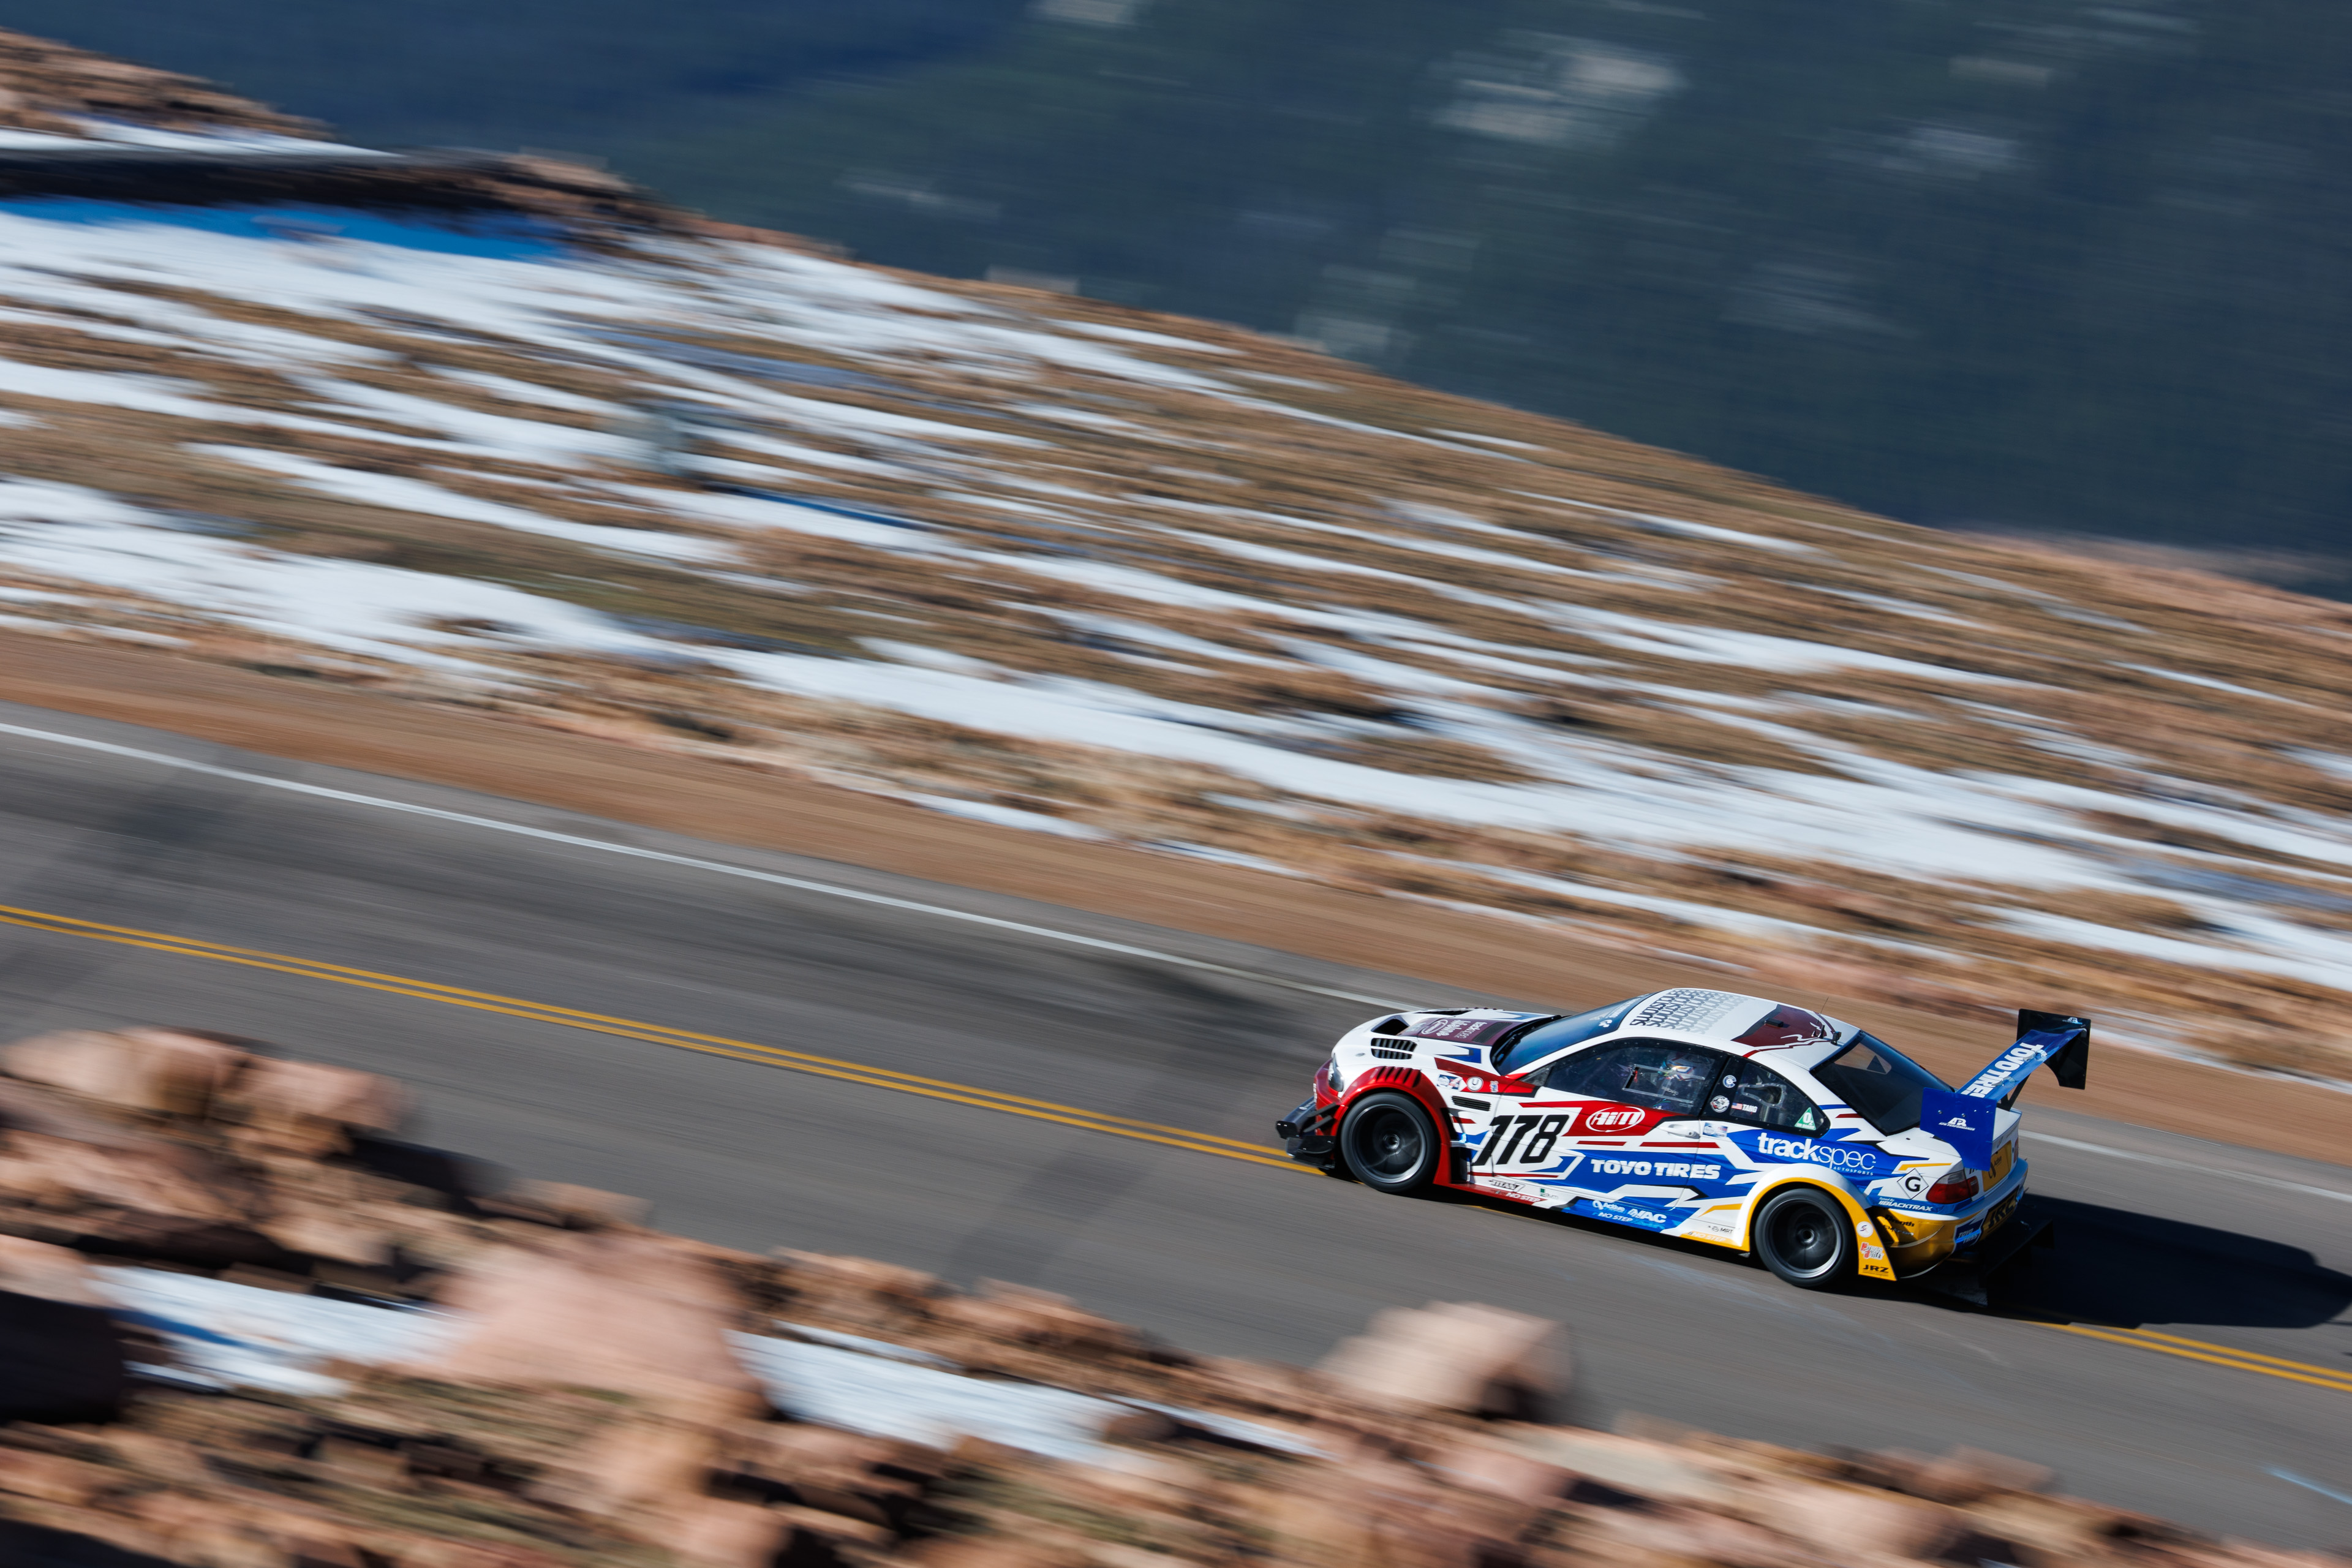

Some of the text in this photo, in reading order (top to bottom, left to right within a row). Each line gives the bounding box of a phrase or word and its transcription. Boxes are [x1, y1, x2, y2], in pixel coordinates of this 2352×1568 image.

[1742, 1104, 1758, 1113] TANG
[1471, 1114, 1570, 1167] 178
[1757, 1133, 1876, 1170] trackspec
[1591, 1159, 1721, 1180] TOYO TIRES
[1833, 1166, 1874, 1176] AUTOSPORTS
[1905, 1176, 1921, 1192] G
[1958, 1228, 1974, 1238] TOYO
[1863, 1264, 1889, 1273] JRZ
